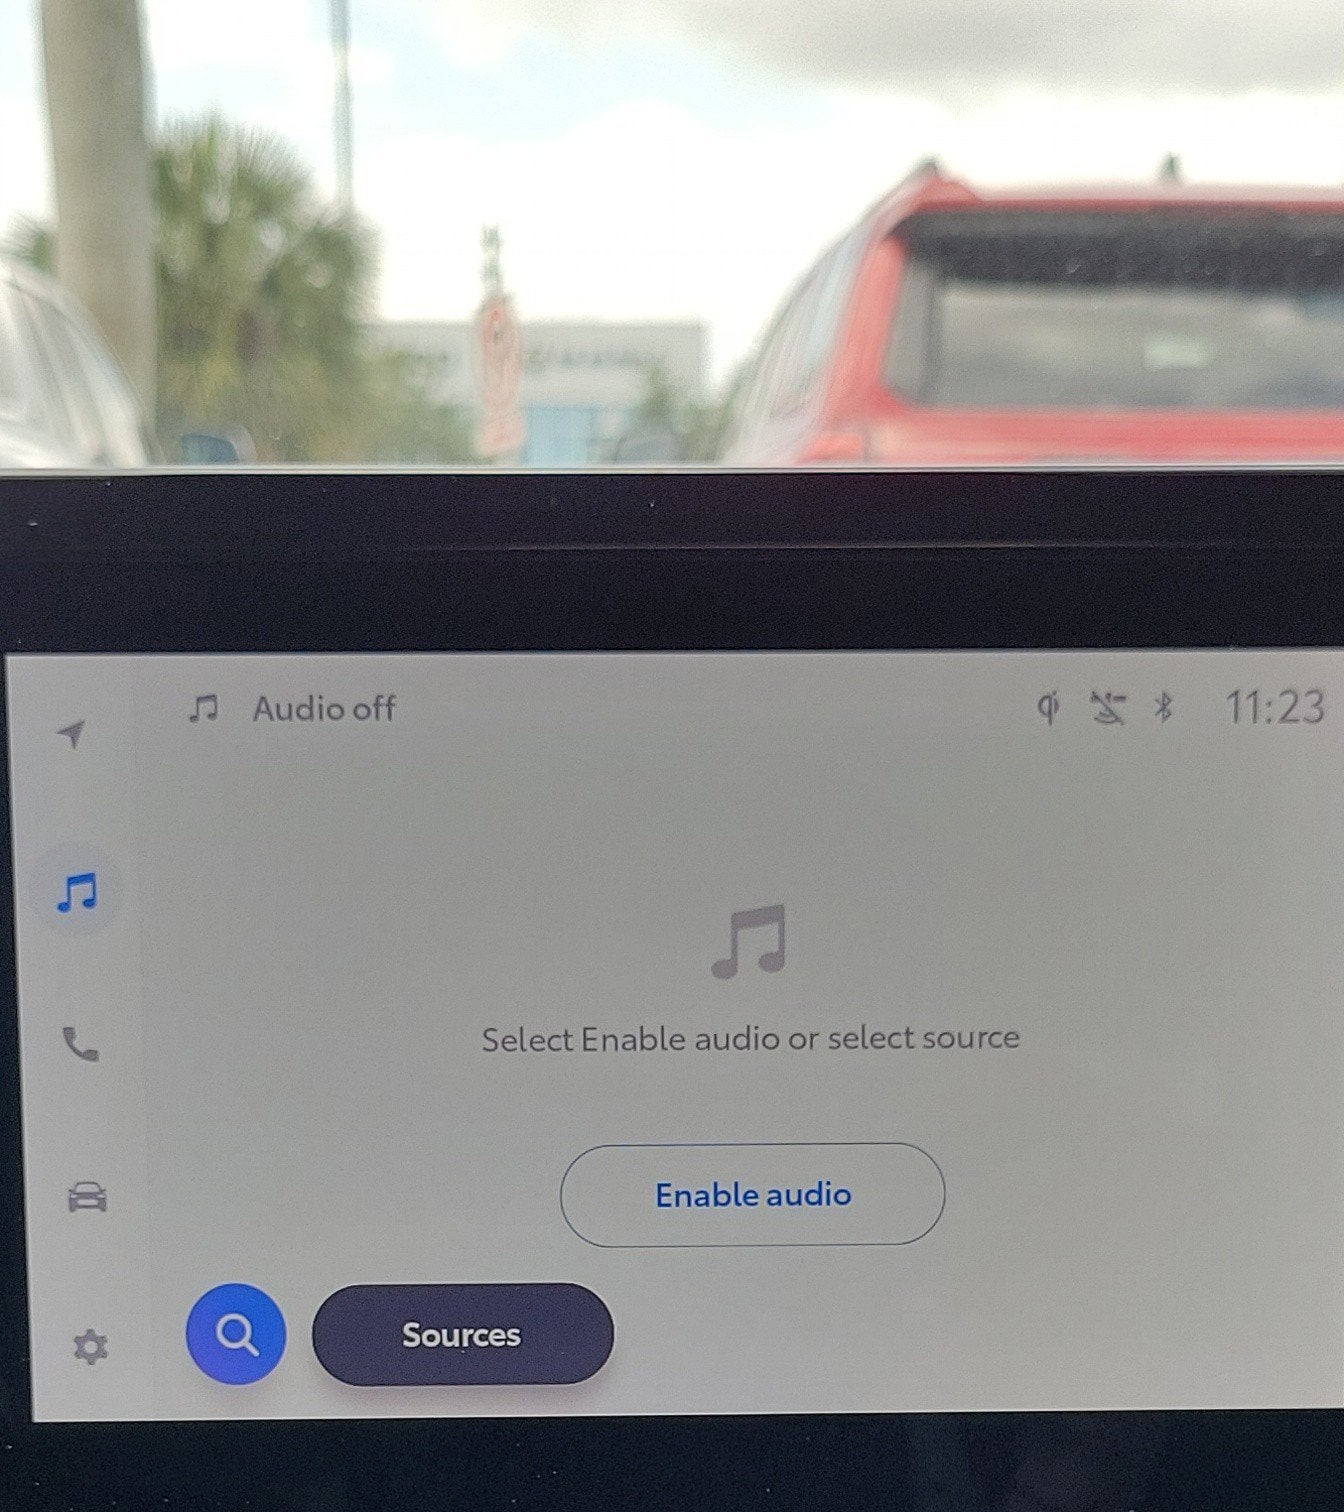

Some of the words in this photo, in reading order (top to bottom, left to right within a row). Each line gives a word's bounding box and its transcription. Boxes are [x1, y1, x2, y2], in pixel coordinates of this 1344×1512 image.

[253, 695, 344, 721] Audio
[353, 694, 396, 721] off
[1227, 689, 1324, 724] 11:23
[483, 1026, 573, 1052] Select
[583, 1025, 685, 1051] Enable
[696, 1025, 779, 1050] audio
[789, 1033, 819, 1050] or
[829, 1024, 915, 1050] select
[924, 1031, 1020, 1049] source
[657, 1182, 759, 1207] Enable
[767, 1181, 851, 1206] audio
[404, 1322, 520, 1347] Sources
